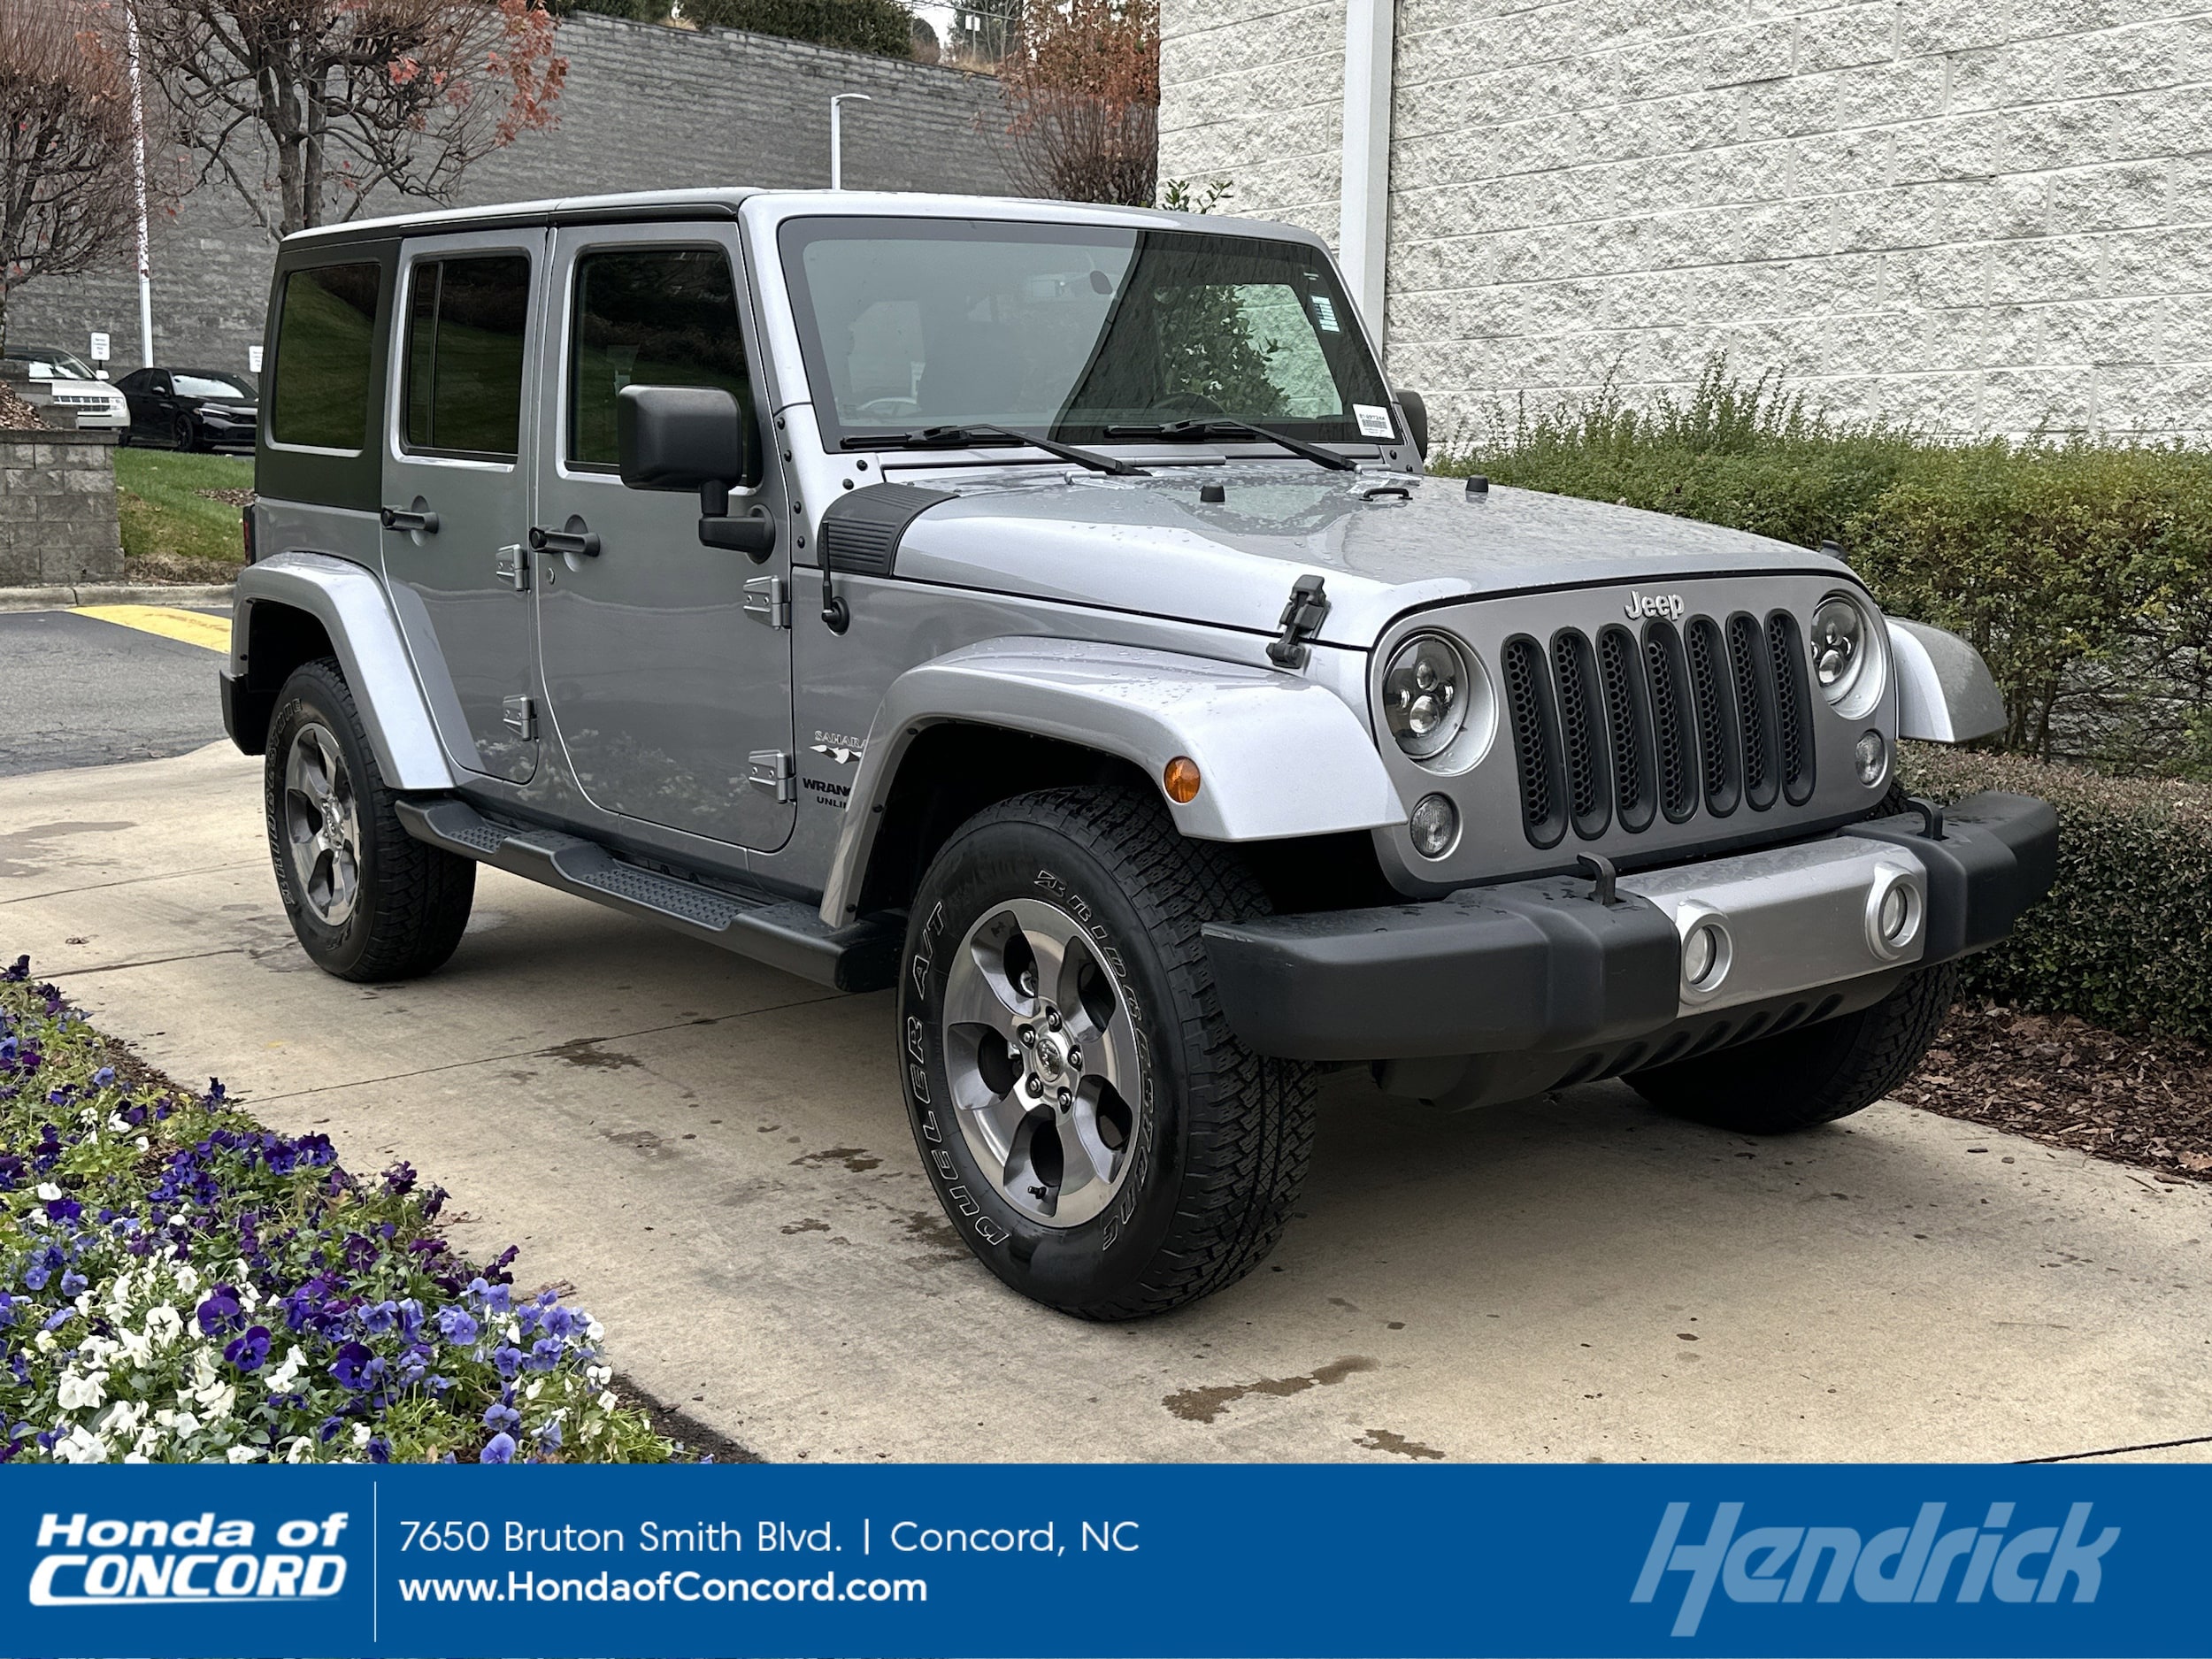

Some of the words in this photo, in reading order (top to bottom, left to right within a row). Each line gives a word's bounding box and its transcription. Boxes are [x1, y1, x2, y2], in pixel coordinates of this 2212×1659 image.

[1624, 589, 1685, 621] Jeep
[912, 901, 946, 1001] A/T
[907, 1016, 1010, 1246] DUELER
[1033, 870, 1154, 1251] BRIDGESTONE
